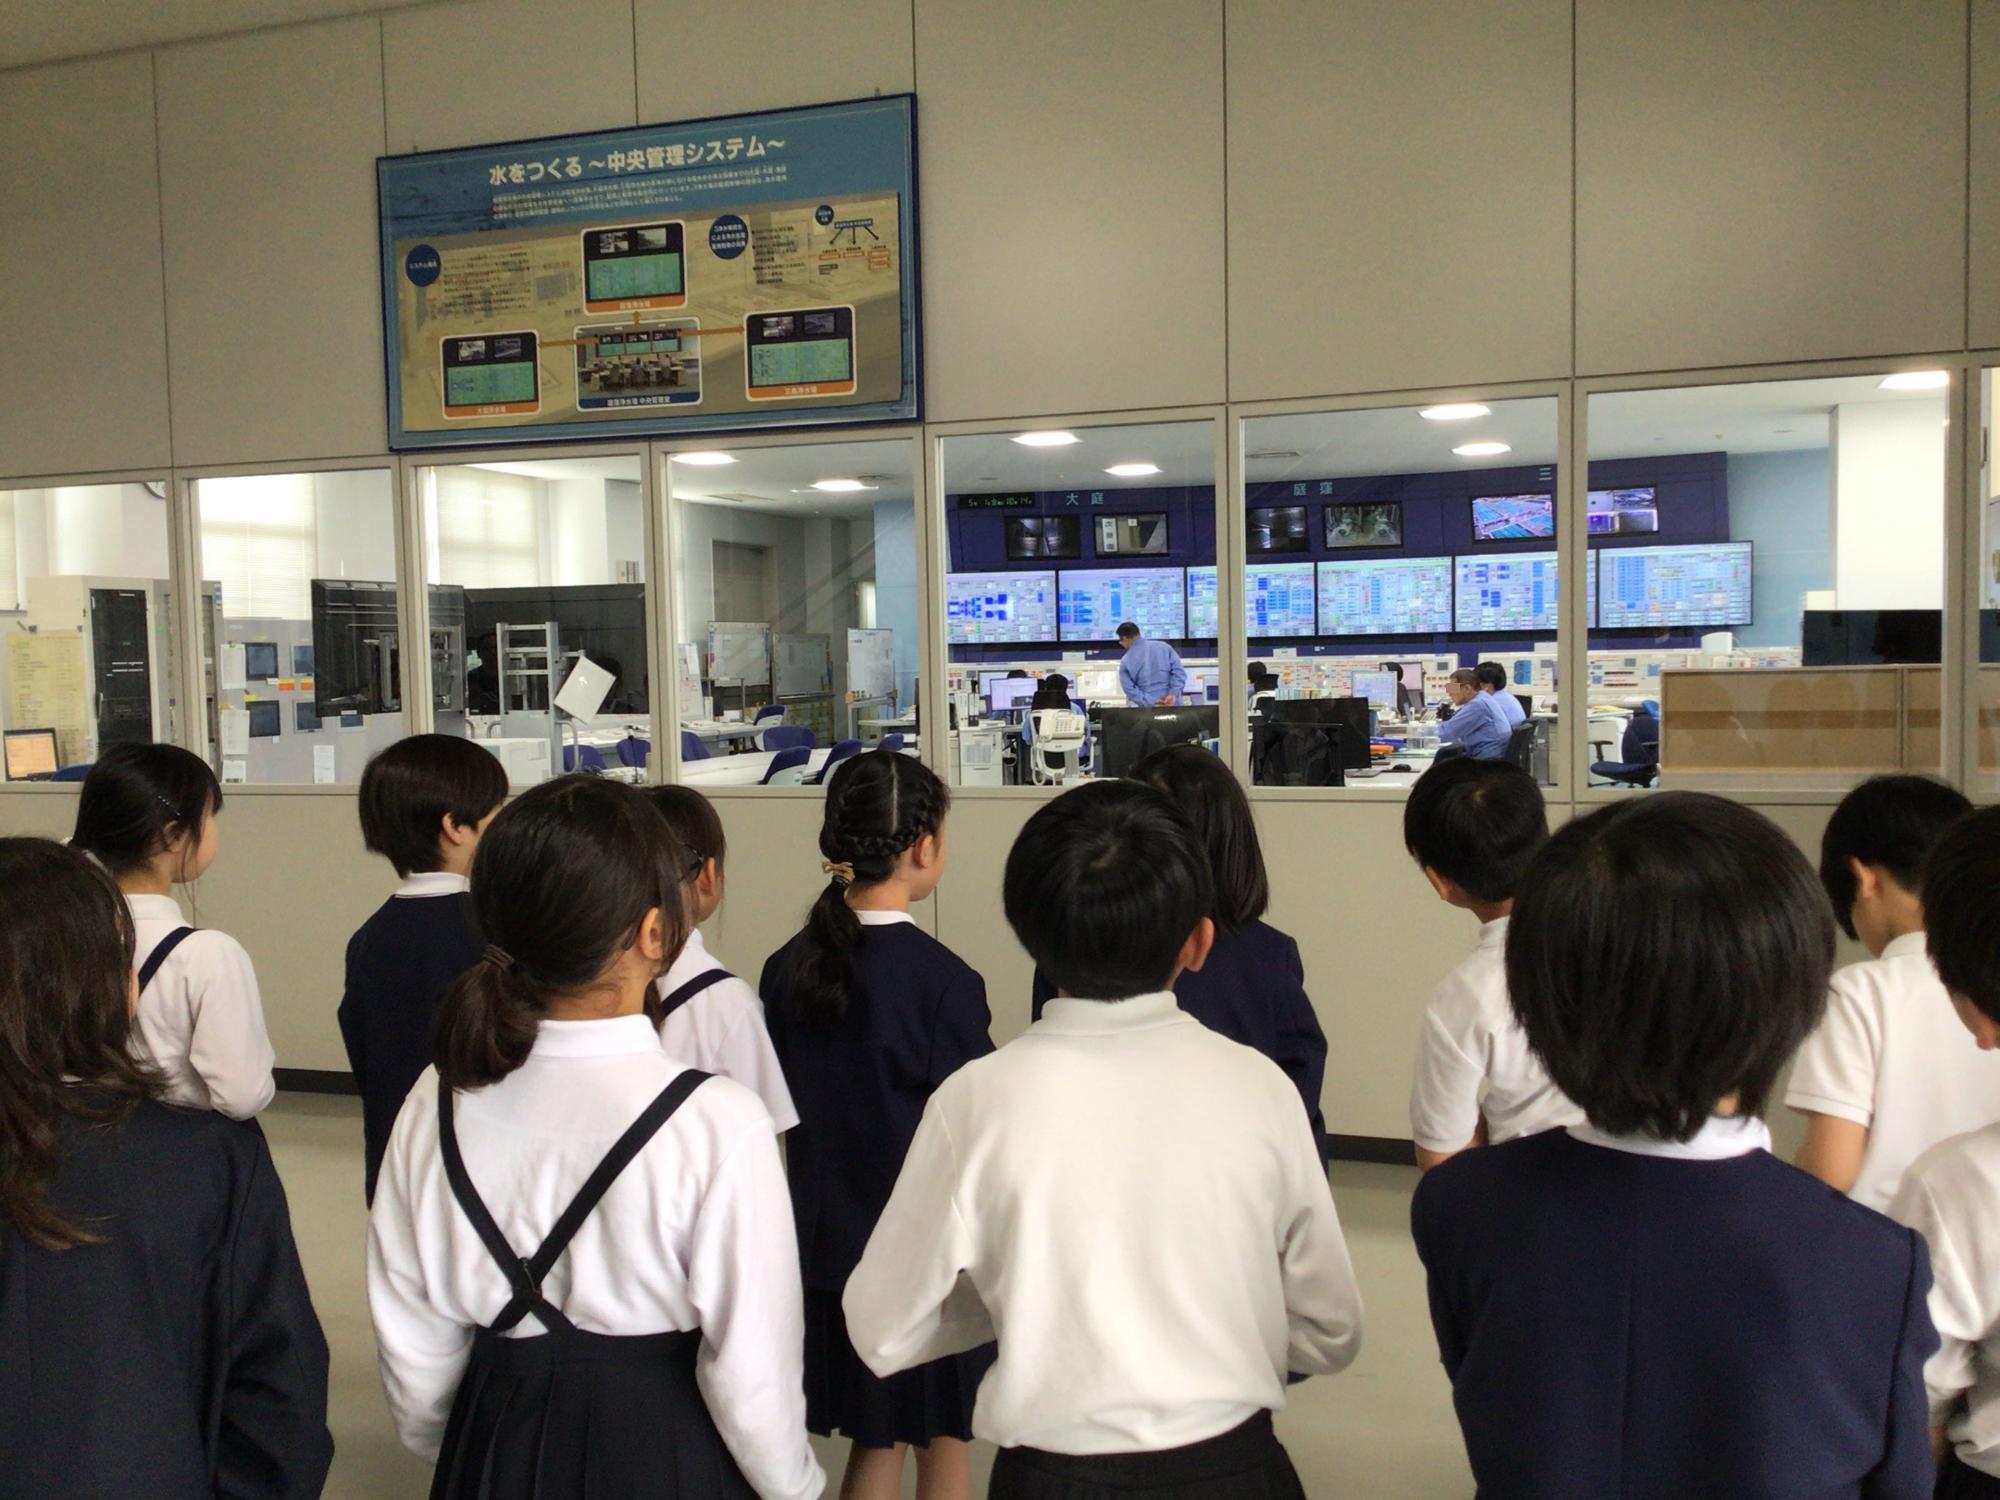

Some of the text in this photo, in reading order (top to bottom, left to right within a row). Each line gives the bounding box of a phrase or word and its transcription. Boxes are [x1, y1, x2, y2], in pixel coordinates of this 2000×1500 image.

[489, 136, 785, 186] 水をつくる ～中央管理システム～
